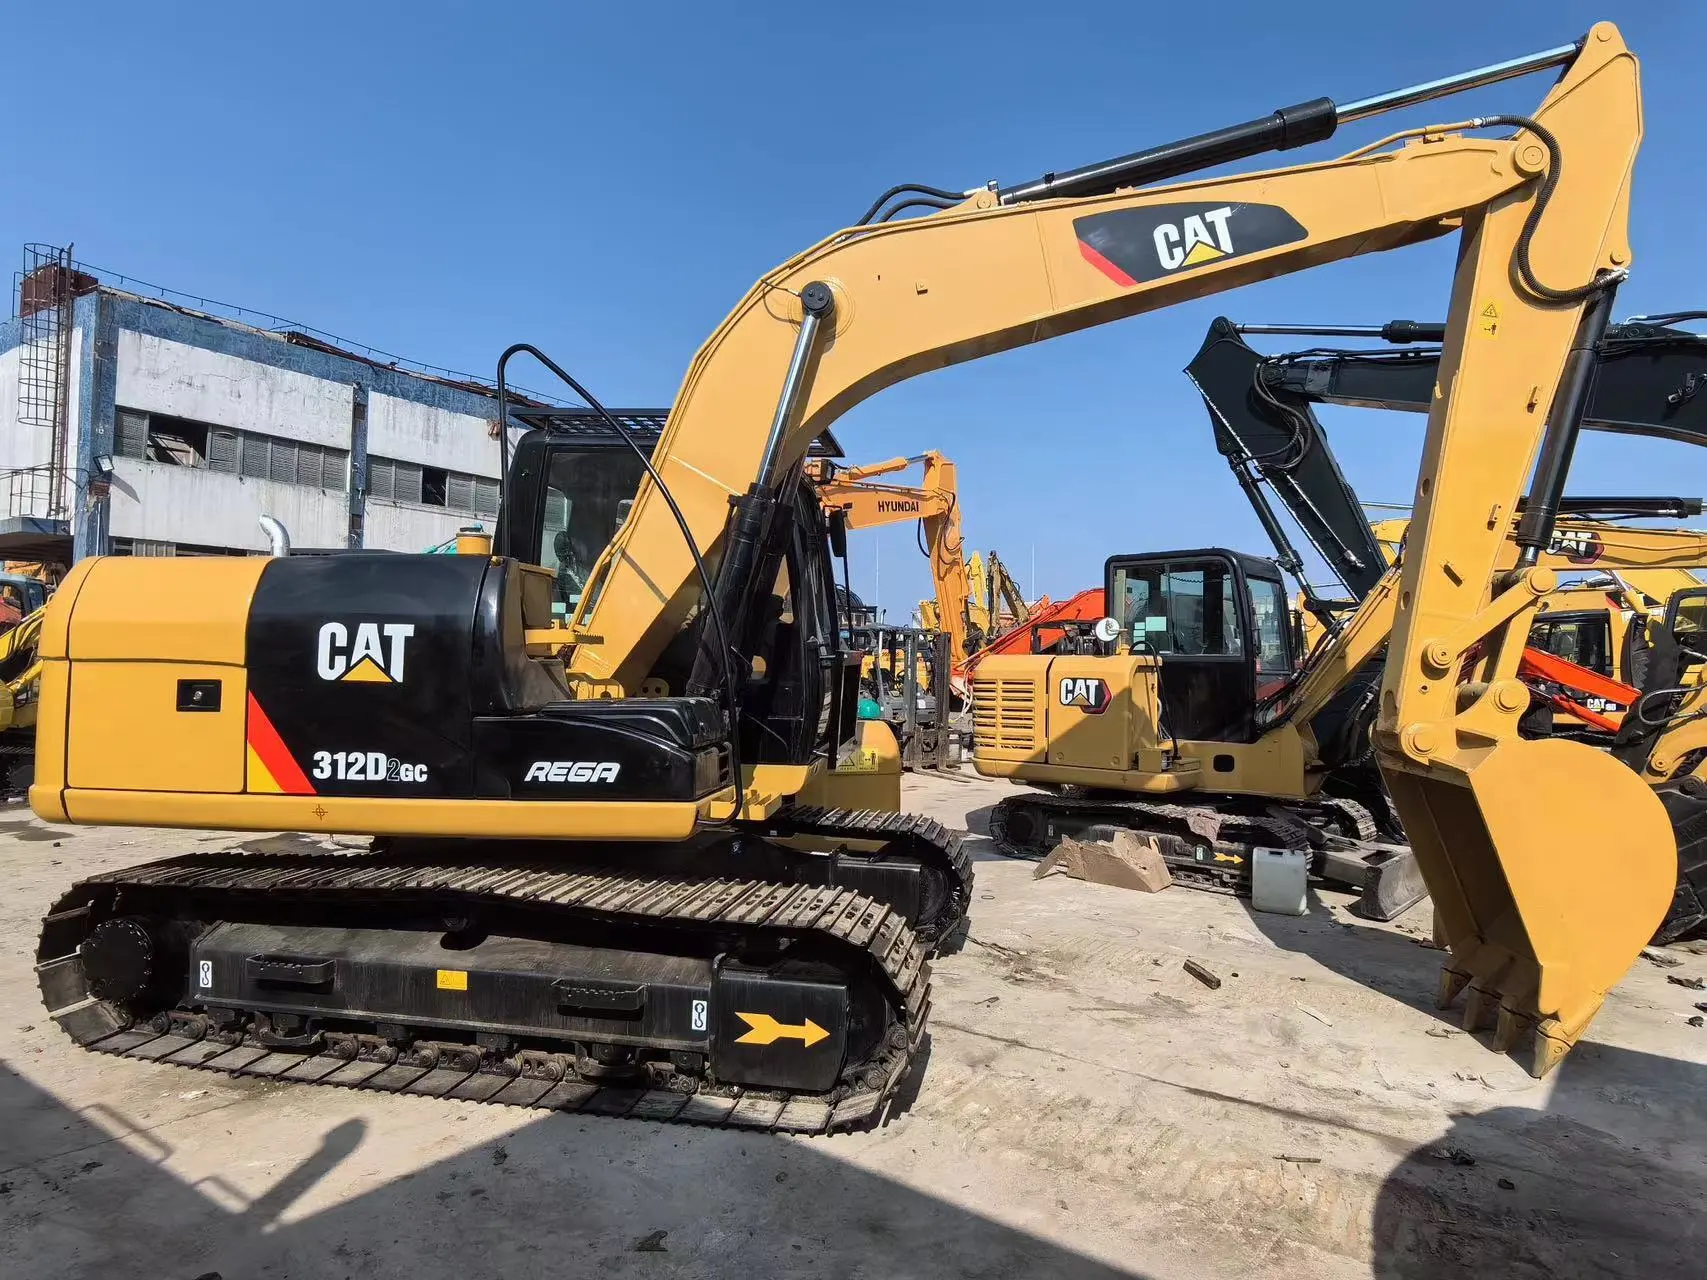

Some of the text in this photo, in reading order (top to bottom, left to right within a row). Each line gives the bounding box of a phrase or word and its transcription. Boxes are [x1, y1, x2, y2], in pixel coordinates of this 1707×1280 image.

[1153, 206, 1234, 270] CAT
[877, 500, 920, 513] HYUNDAI
[317, 622, 415, 683] CAT
[1060, 678, 1099, 706] CAT
[1586, 698, 1607, 710] CAT
[523, 761, 621, 783] REGA
